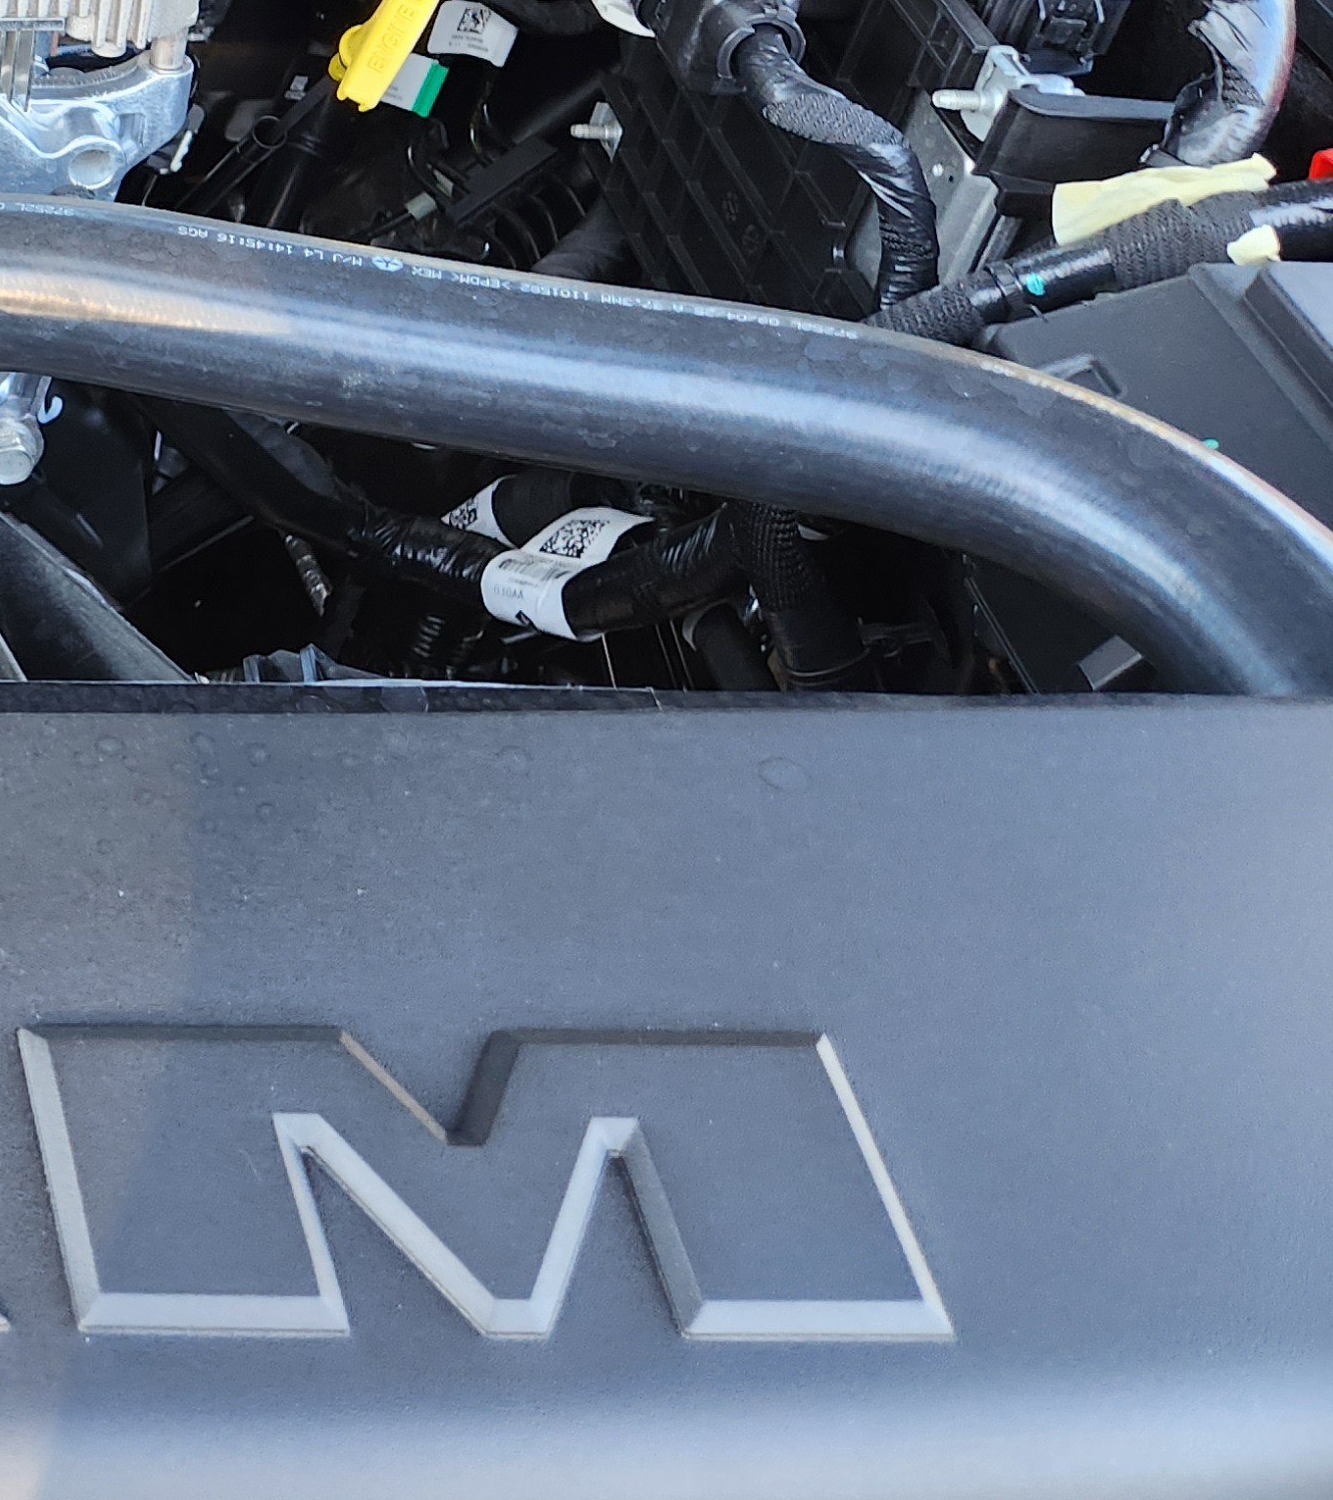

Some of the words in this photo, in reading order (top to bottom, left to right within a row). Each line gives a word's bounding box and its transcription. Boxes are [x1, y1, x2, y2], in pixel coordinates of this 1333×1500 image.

[366, 4, 417, 74] ENGINE
[176, 225, 208, 240] AGS
[216, 231, 293, 256] 14:45:16
[303, 247, 324, 260] L4
[332, 251, 363, 268] M/J
[411, 264, 442, 280] MEX
[449, 271, 511, 291] >EPDM<
